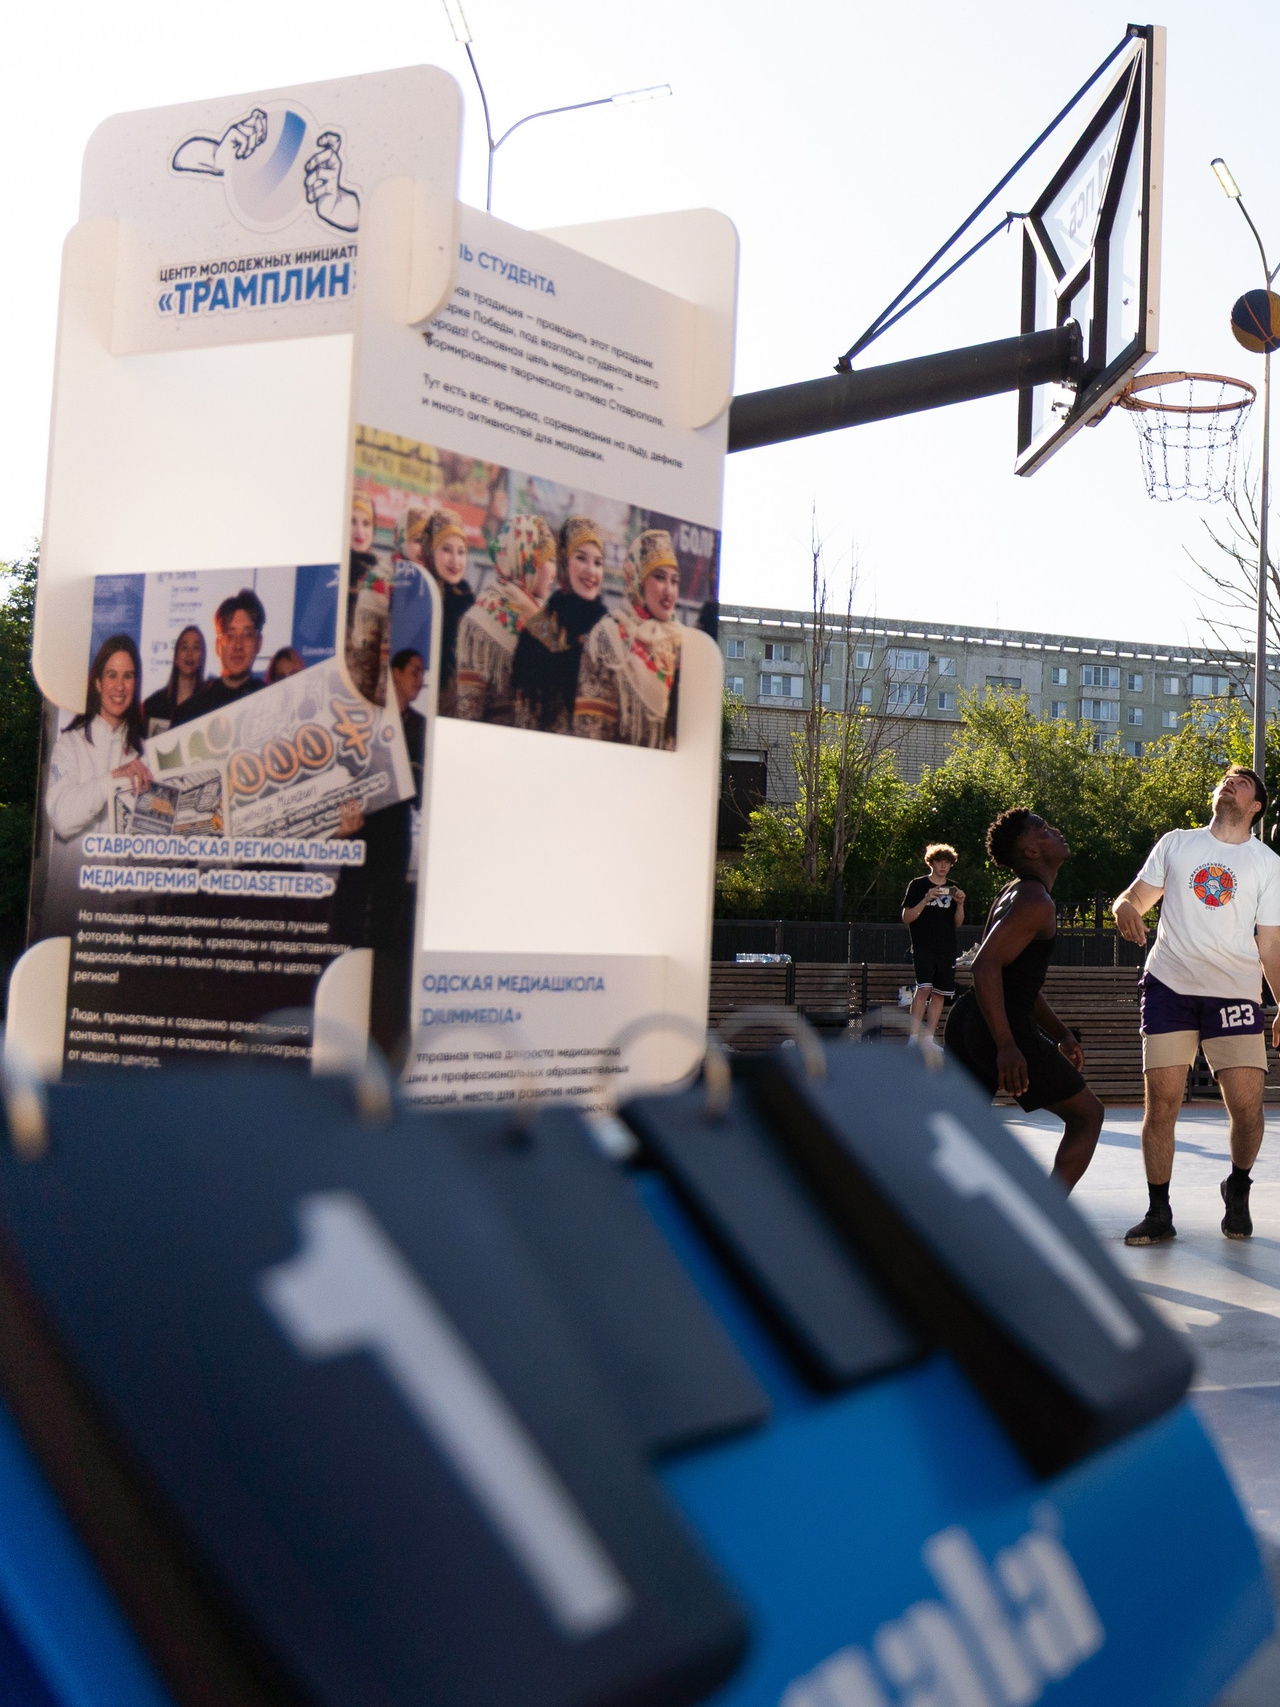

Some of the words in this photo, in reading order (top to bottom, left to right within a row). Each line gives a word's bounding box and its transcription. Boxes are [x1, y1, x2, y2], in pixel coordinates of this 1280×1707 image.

[159, 265, 197, 282] ЦЕНТР
[199, 253, 292, 278] МОЛОДЕЖНЫХ
[295, 244, 358, 264] ИНИЦИАТ
[477, 251, 556, 296] СТУДЕНТА
[158, 262, 357, 315] «ТРАМПЛИН
[473, 292, 523, 319] традиция
[536, 317, 587, 343] проводить
[589, 338, 610, 352] этот
[611, 346, 654, 369] праздник
[430, 319, 469, 338] орода!
[471, 329, 524, 358] Основная
[526, 352, 549, 367] цель
[551, 361, 614, 391] мероприятия
[473, 309, 517, 338] Победы,
[519, 329, 539, 345] под
[540, 338, 585, 361] возгласы
[586, 355, 633, 380] студентов
[634, 373, 659, 389] всего
[510, 365, 573, 395] творческого
[573, 388, 607, 407] актива
[608, 398, 665, 428] Ставрополя.
[423, 372, 440, 389] Тут
[442, 382, 467, 398] есть
[493, 399, 541, 424] ярмарка,
[543, 415, 612, 446] соревнования
[613, 438, 626, 450] на
[650, 451, 684, 469] дефиле
[431, 399, 465, 418] много
[467, 410, 533, 439] активностей
[534, 432, 553, 446] для
[554, 438, 605, 462] молодежи.
[84, 836, 230, 857] СТАВРОПОЛЬСКАЯ
[234, 840, 362, 861] РЕГИОНАЛЬНАЯ
[82, 868, 197, 889] МЕДИАПРЕМИЯ
[201, 873, 332, 894] «MEDIASETTERS»
[79, 909, 93, 923] На
[94, 911, 146, 926] площадке
[147, 914, 219, 929] медиапремии
[220, 916, 286, 932] собираются
[287, 920, 330, 935] лучшие
[77, 929, 136, 946] фотографы,
[138, 933, 204, 951] видеографы,
[206, 938, 258, 953] креаторы
[74, 970, 120, 983] региона!
[75, 951, 163, 967] медиасообществ
[164, 956, 178, 967] не
[179, 957, 215, 969] только
[215, 959, 257, 973] города,
[258, 961, 274, 973] но
[283, 963, 321, 976] целого
[498, 975, 606, 994] МЕДИАШКОЛА
[71, 1007, 102, 1023] Люди,
[103, 1012, 166, 1027] причастные
[175, 1017, 228, 1031] созданию
[229, 1020, 309, 1035] качественного
[420, 1007, 522, 1027] DIUMMEDIA»
[1219, 1003, 1255, 1028] 123
[70, 1030, 118, 1045] контента,
[120, 1034, 161, 1048] никогда
[162, 1037, 176, 1048] не
[177, 1038, 227, 1052] остаются
[228, 1039, 249, 1054] без
[68, 1050, 80, 1061] от
[81, 1050, 120, 1065] нашего
[930, 1110, 1143, 1351] 1
[260, 1189, 633, 1639] 1
